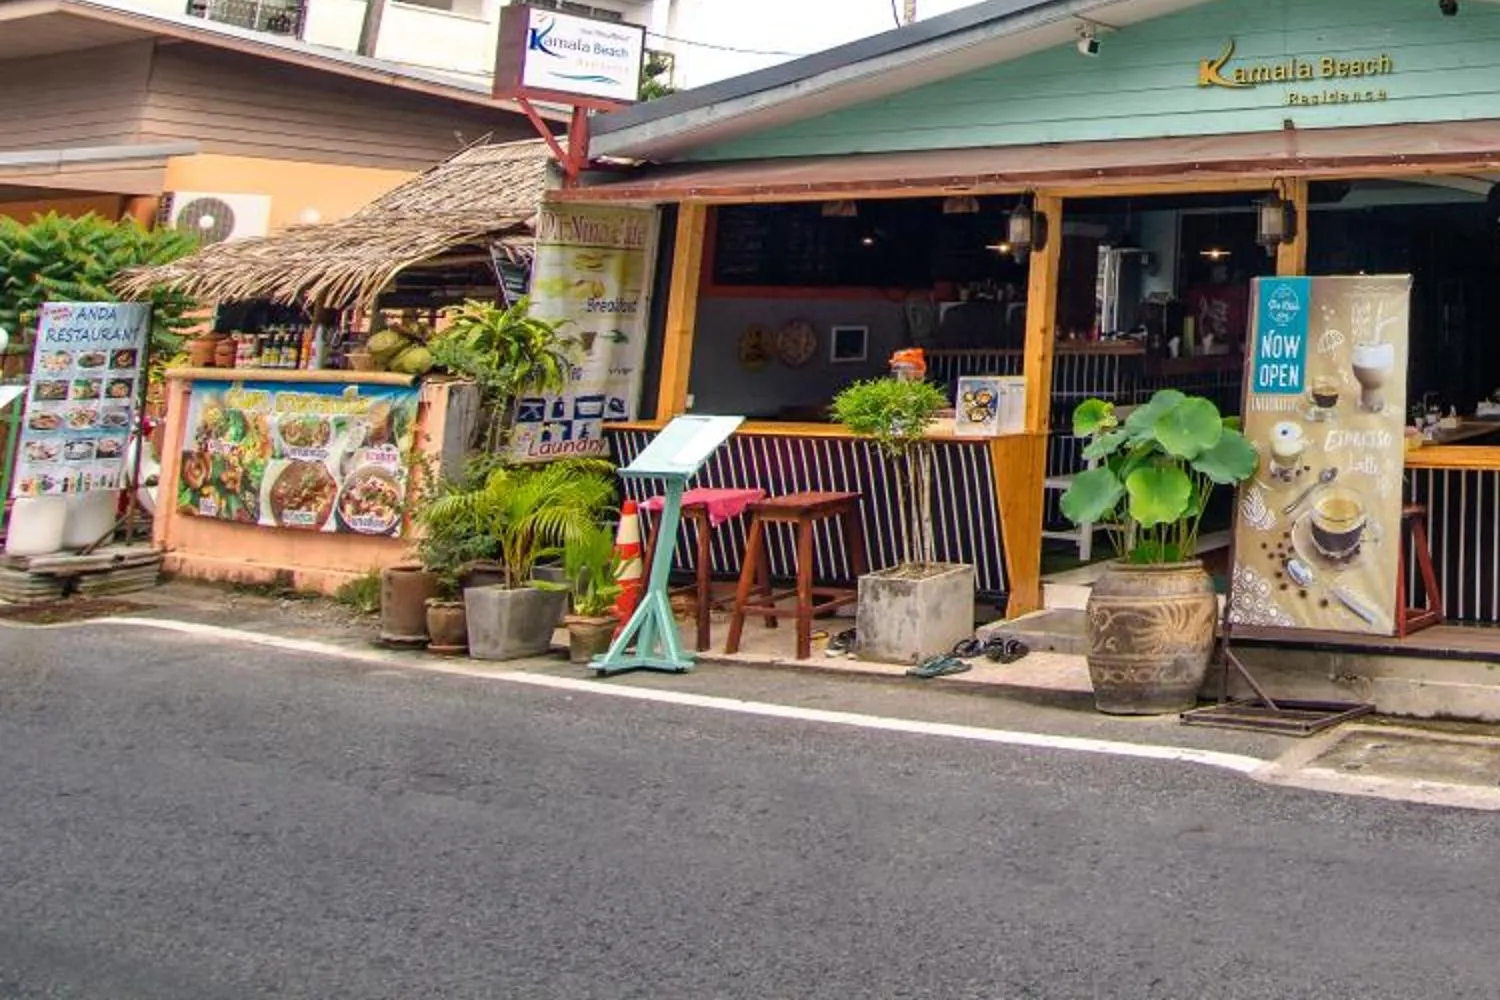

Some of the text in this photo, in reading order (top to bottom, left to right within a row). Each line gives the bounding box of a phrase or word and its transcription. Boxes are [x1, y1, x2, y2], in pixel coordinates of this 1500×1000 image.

[529, 17, 591, 58] Kamala
[593, 42, 630, 57] Beach
[1198, 37, 1393, 89] Kamala Beach
[76, 307, 117, 321] ANDA
[46, 327, 140, 342] RESTAURANT
[1261, 330, 1300, 358] NOW
[1259, 364, 1299, 387] OPEN
[528, 438, 607, 457] Laundry
